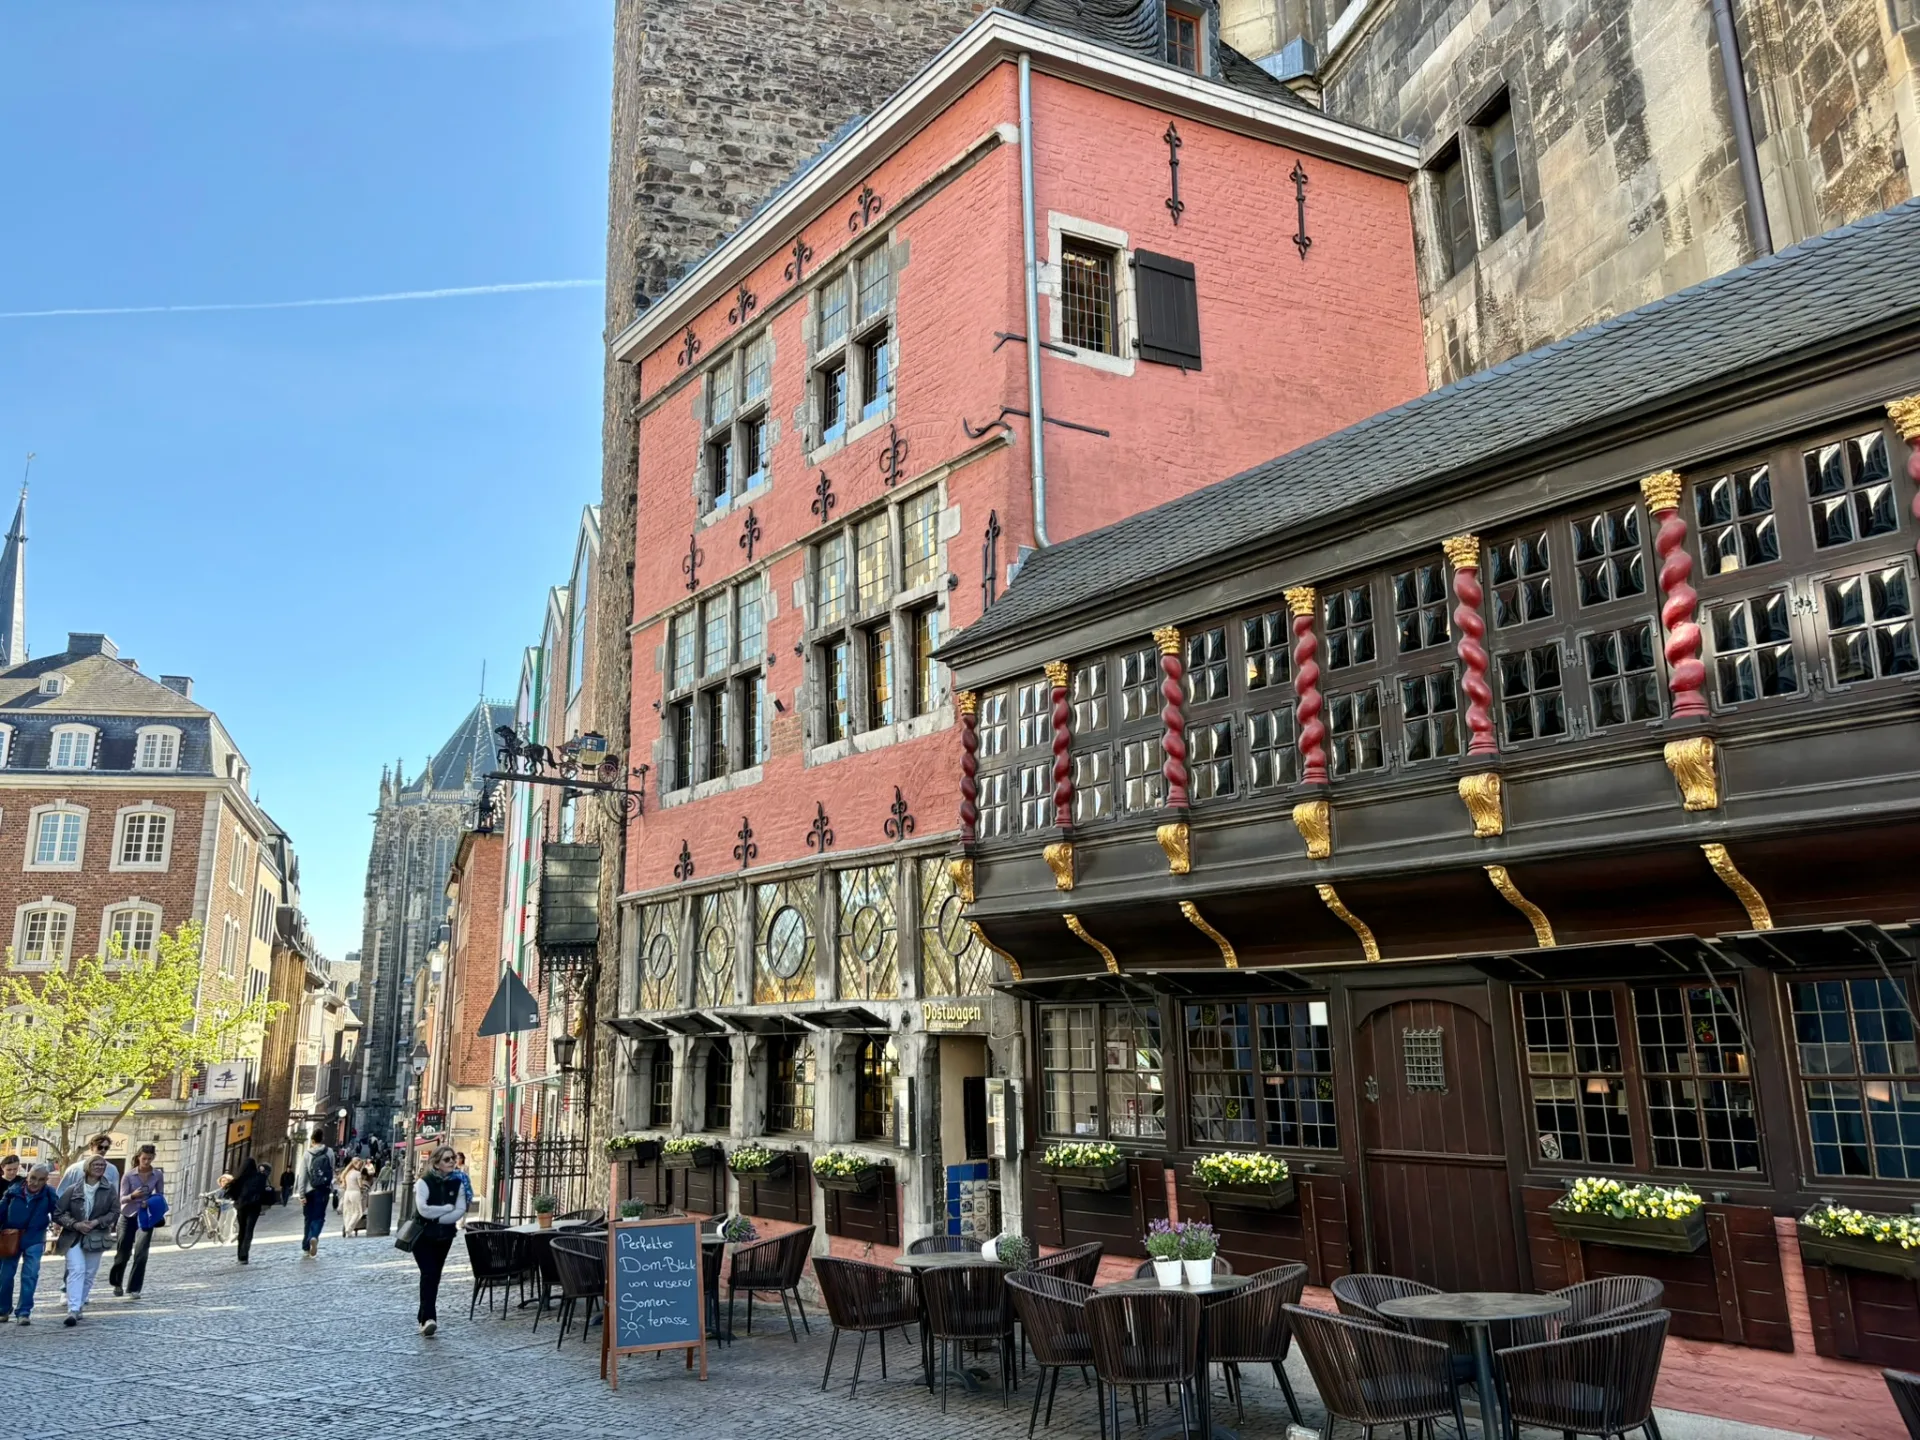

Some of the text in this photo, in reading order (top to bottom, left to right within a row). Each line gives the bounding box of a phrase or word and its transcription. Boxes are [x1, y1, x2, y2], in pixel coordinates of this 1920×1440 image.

[922, 1002, 981, 1030] Postwagen
[618, 1232, 674, 1252] Perfektes
[619, 1256, 696, 1273] Dom-Blick
[628, 1279, 692, 1289] von unserer
[619, 1292, 677, 1312] Sonnen-
[647, 1309, 691, 1327] terrasse
